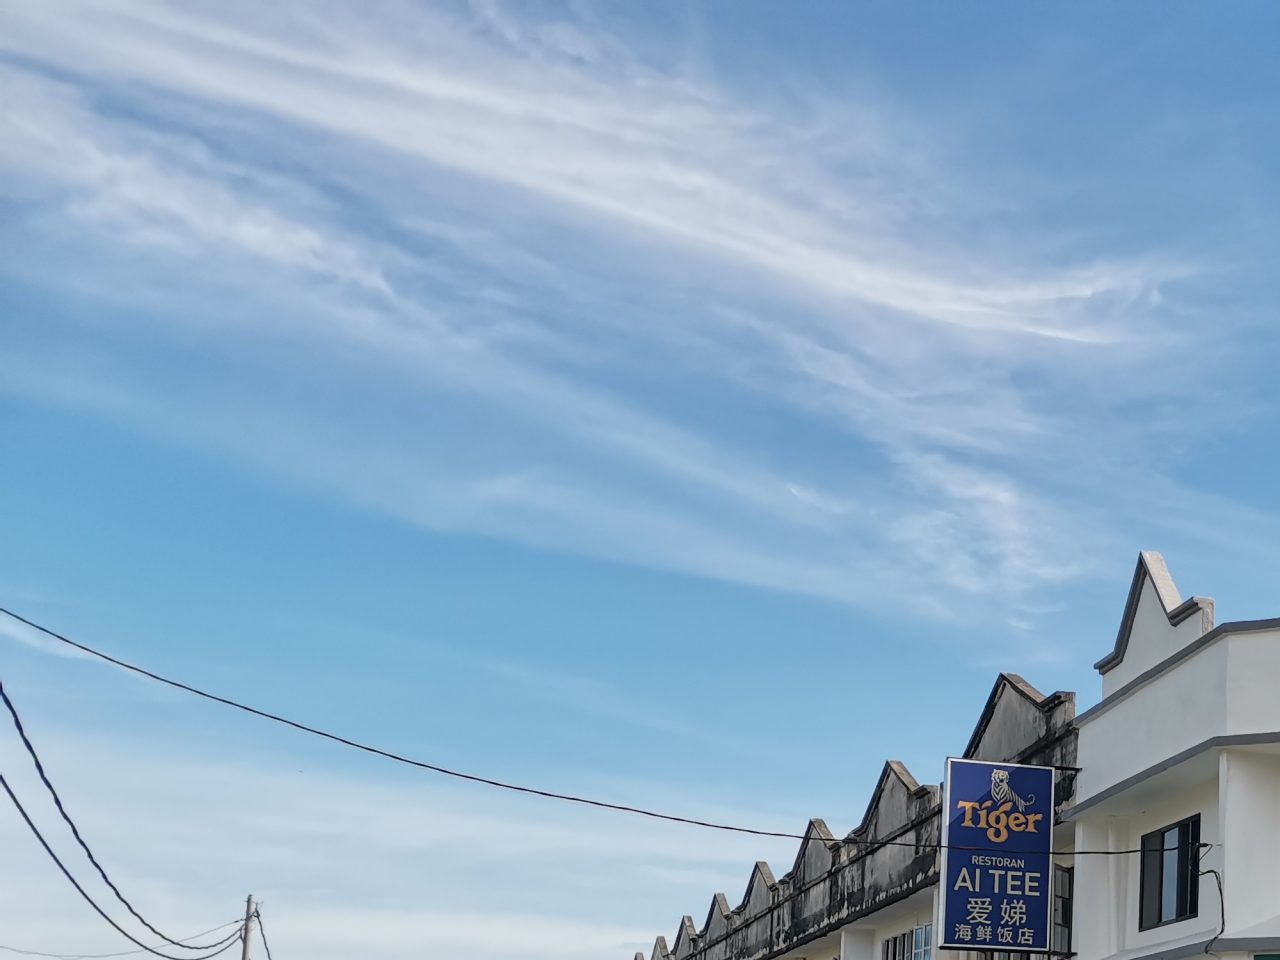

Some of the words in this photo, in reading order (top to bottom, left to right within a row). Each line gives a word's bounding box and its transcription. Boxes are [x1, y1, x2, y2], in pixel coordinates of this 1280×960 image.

[957, 800, 1043, 842] Tiger
[971, 855, 1024, 868] RESTORAN
[954, 867, 981, 893] AI
[989, 869, 1041, 897] TEE
[954, 924, 1034, 944] 海鲜饭店
